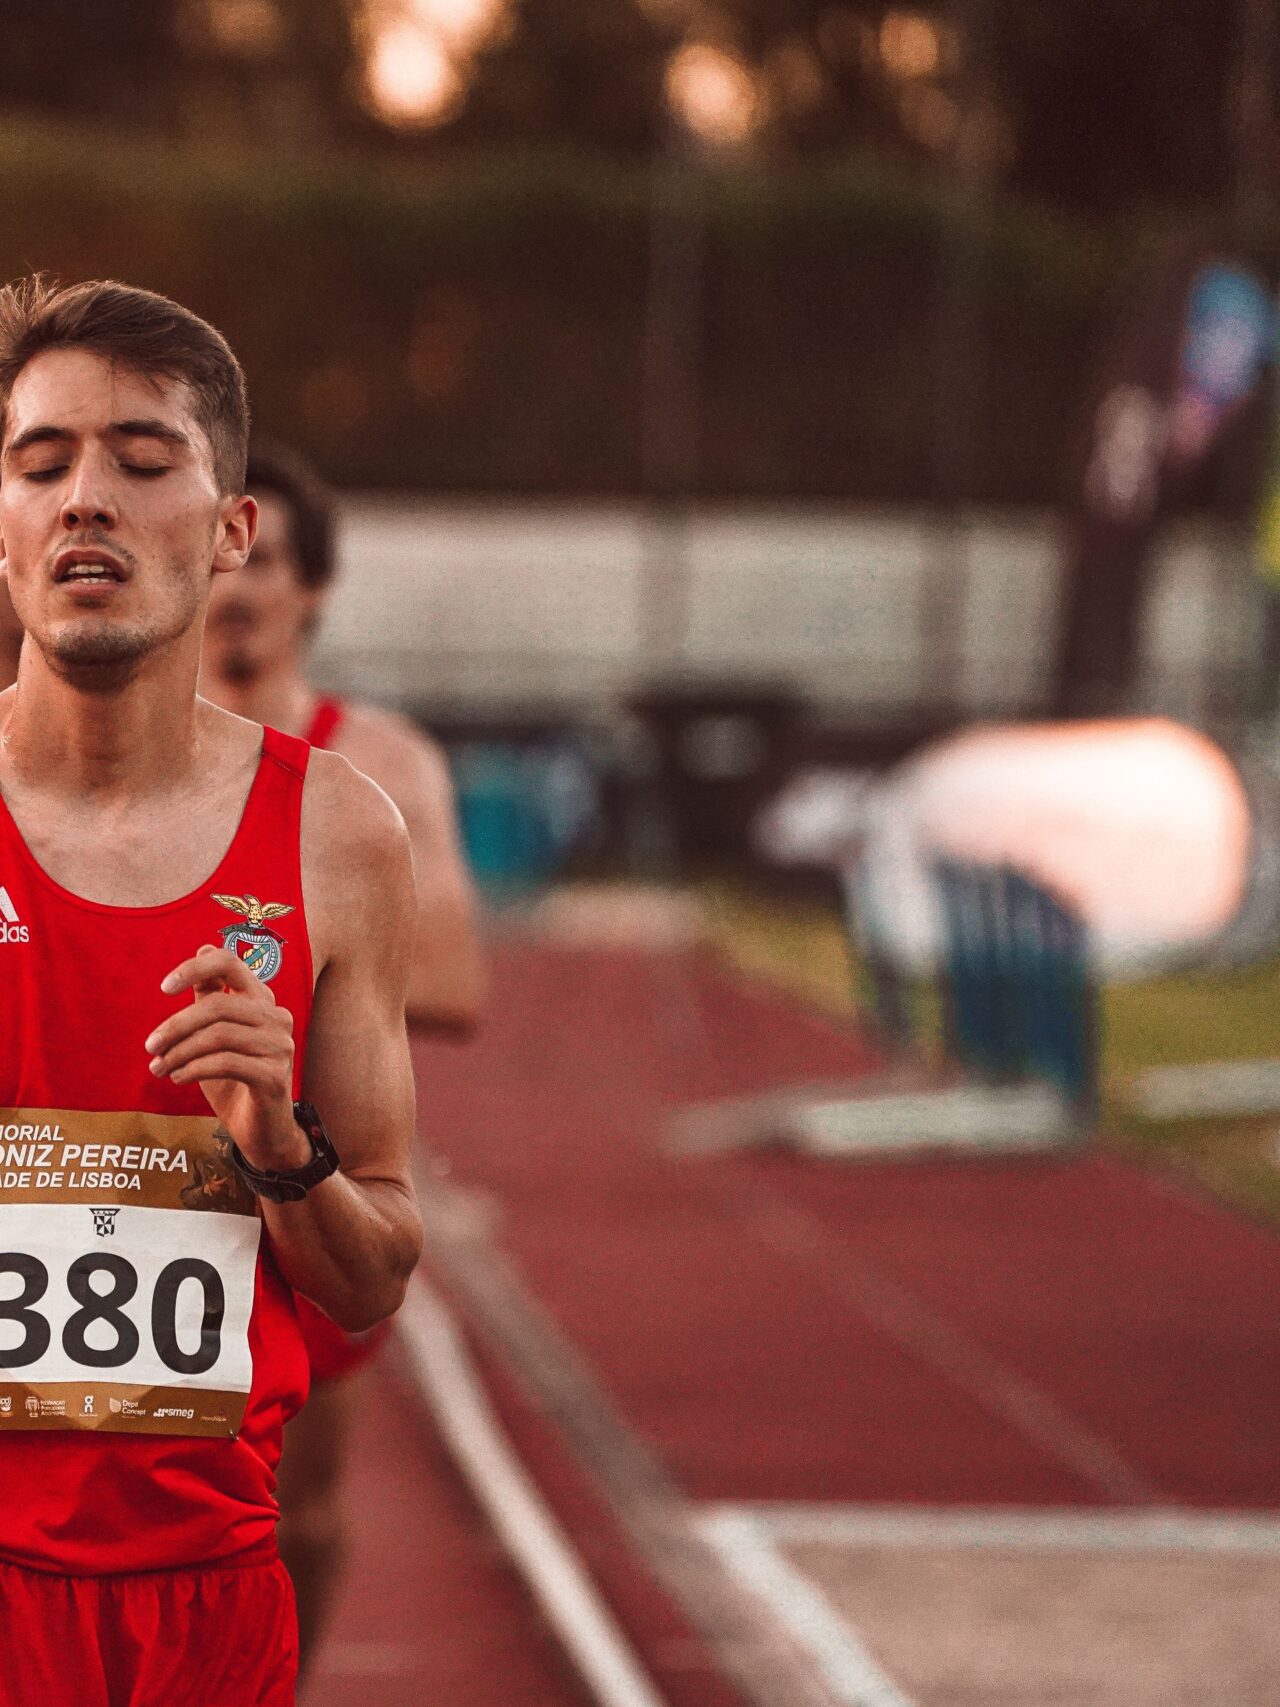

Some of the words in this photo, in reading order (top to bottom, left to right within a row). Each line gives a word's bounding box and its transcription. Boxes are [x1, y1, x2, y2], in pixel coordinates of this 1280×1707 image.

[60, 1144, 189, 1173] PEREIRA
[35, 1172, 64, 1188] DE
[68, 1172, 141, 1190] LISBOA
[122, 1407, 146, 1416] Concept
[169, 1408, 194, 1418] smeg
